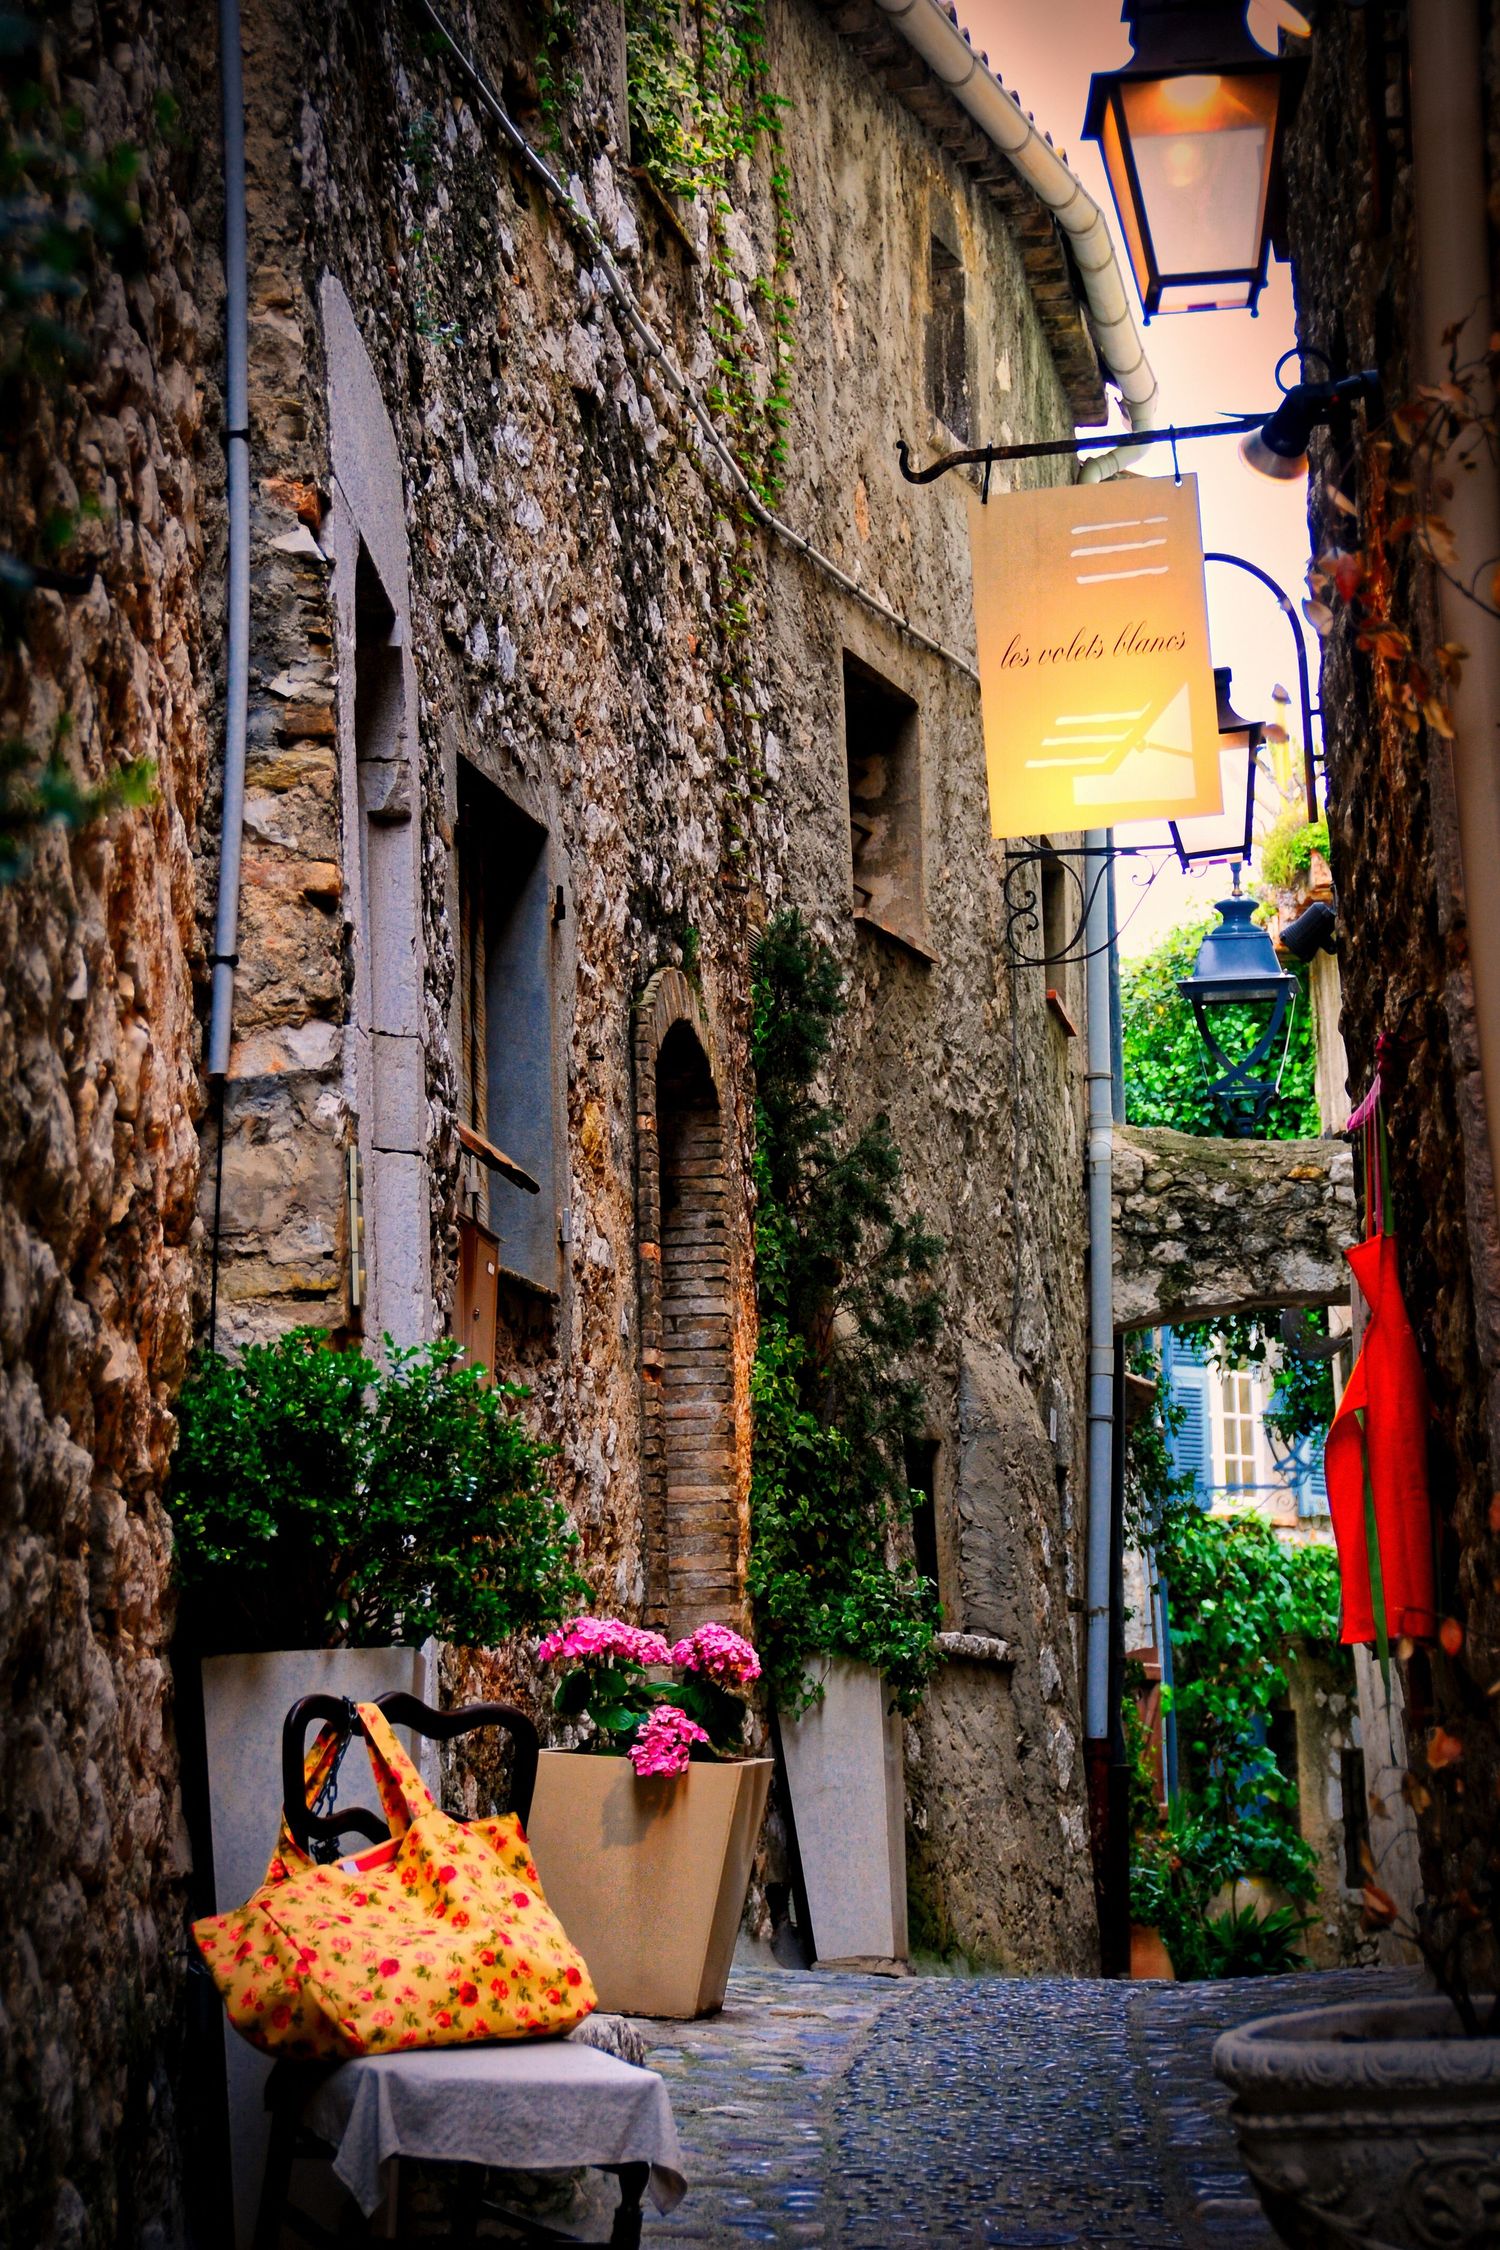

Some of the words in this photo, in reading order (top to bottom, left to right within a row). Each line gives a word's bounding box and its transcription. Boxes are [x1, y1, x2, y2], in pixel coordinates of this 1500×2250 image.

[1001, 633, 1031, 669] les
[1038, 626, 1104, 666] volets
[1112, 620, 1186, 658] blancs
